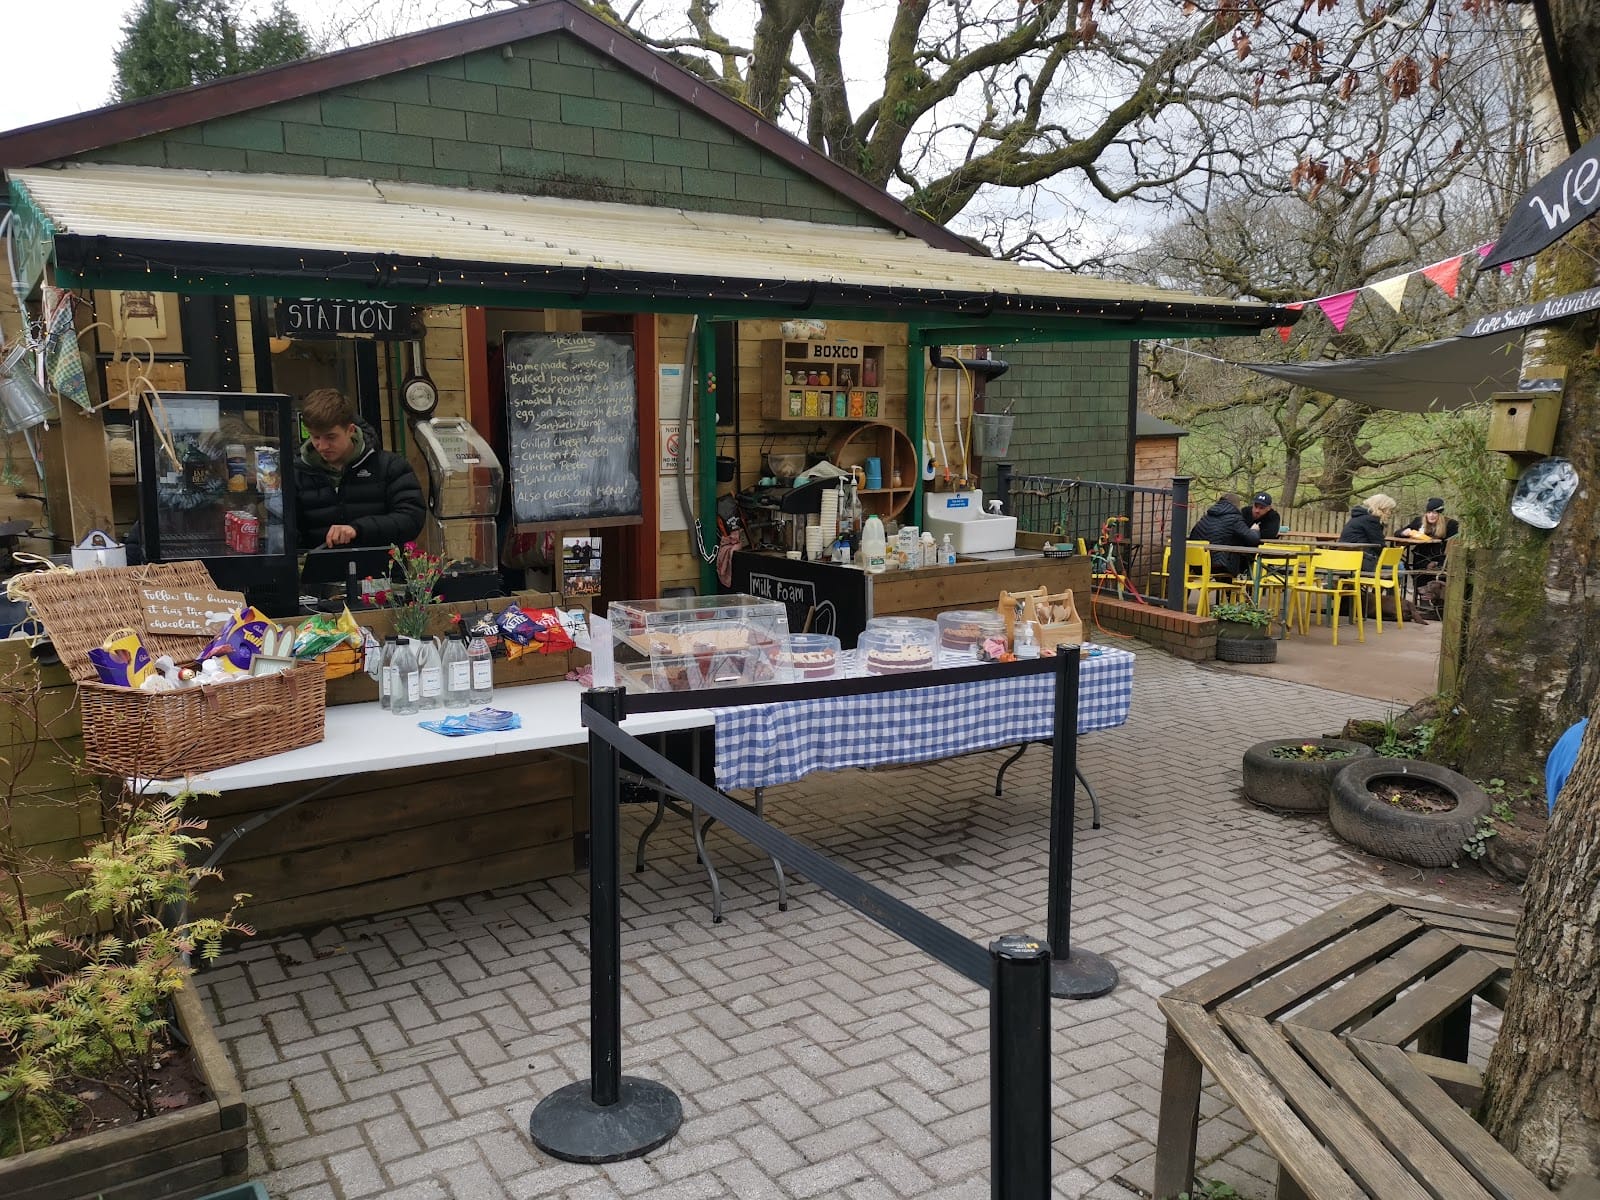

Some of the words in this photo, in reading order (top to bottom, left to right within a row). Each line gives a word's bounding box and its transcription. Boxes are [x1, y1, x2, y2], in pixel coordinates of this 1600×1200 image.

[1502, 308, 1535, 329] Swing
[1539, 291, 1600, 319] Activitie
[288, 304, 392, 331] STATION
[814, 345, 858, 358] BOXCO
[571, 359, 610, 373] Smokey
[531, 383, 589, 397] Sourdough
[520, 438, 550, 450] Grilled
[519, 461, 556, 474] Chicken
[142, 589, 180, 601] Follow
[183, 591, 203, 602] the
[206, 593, 243, 608] bunny
[148, 605, 160, 615] it
[163, 606, 183, 617] has
[186, 606, 205, 617] the
[150, 617, 203, 630] chocolate
